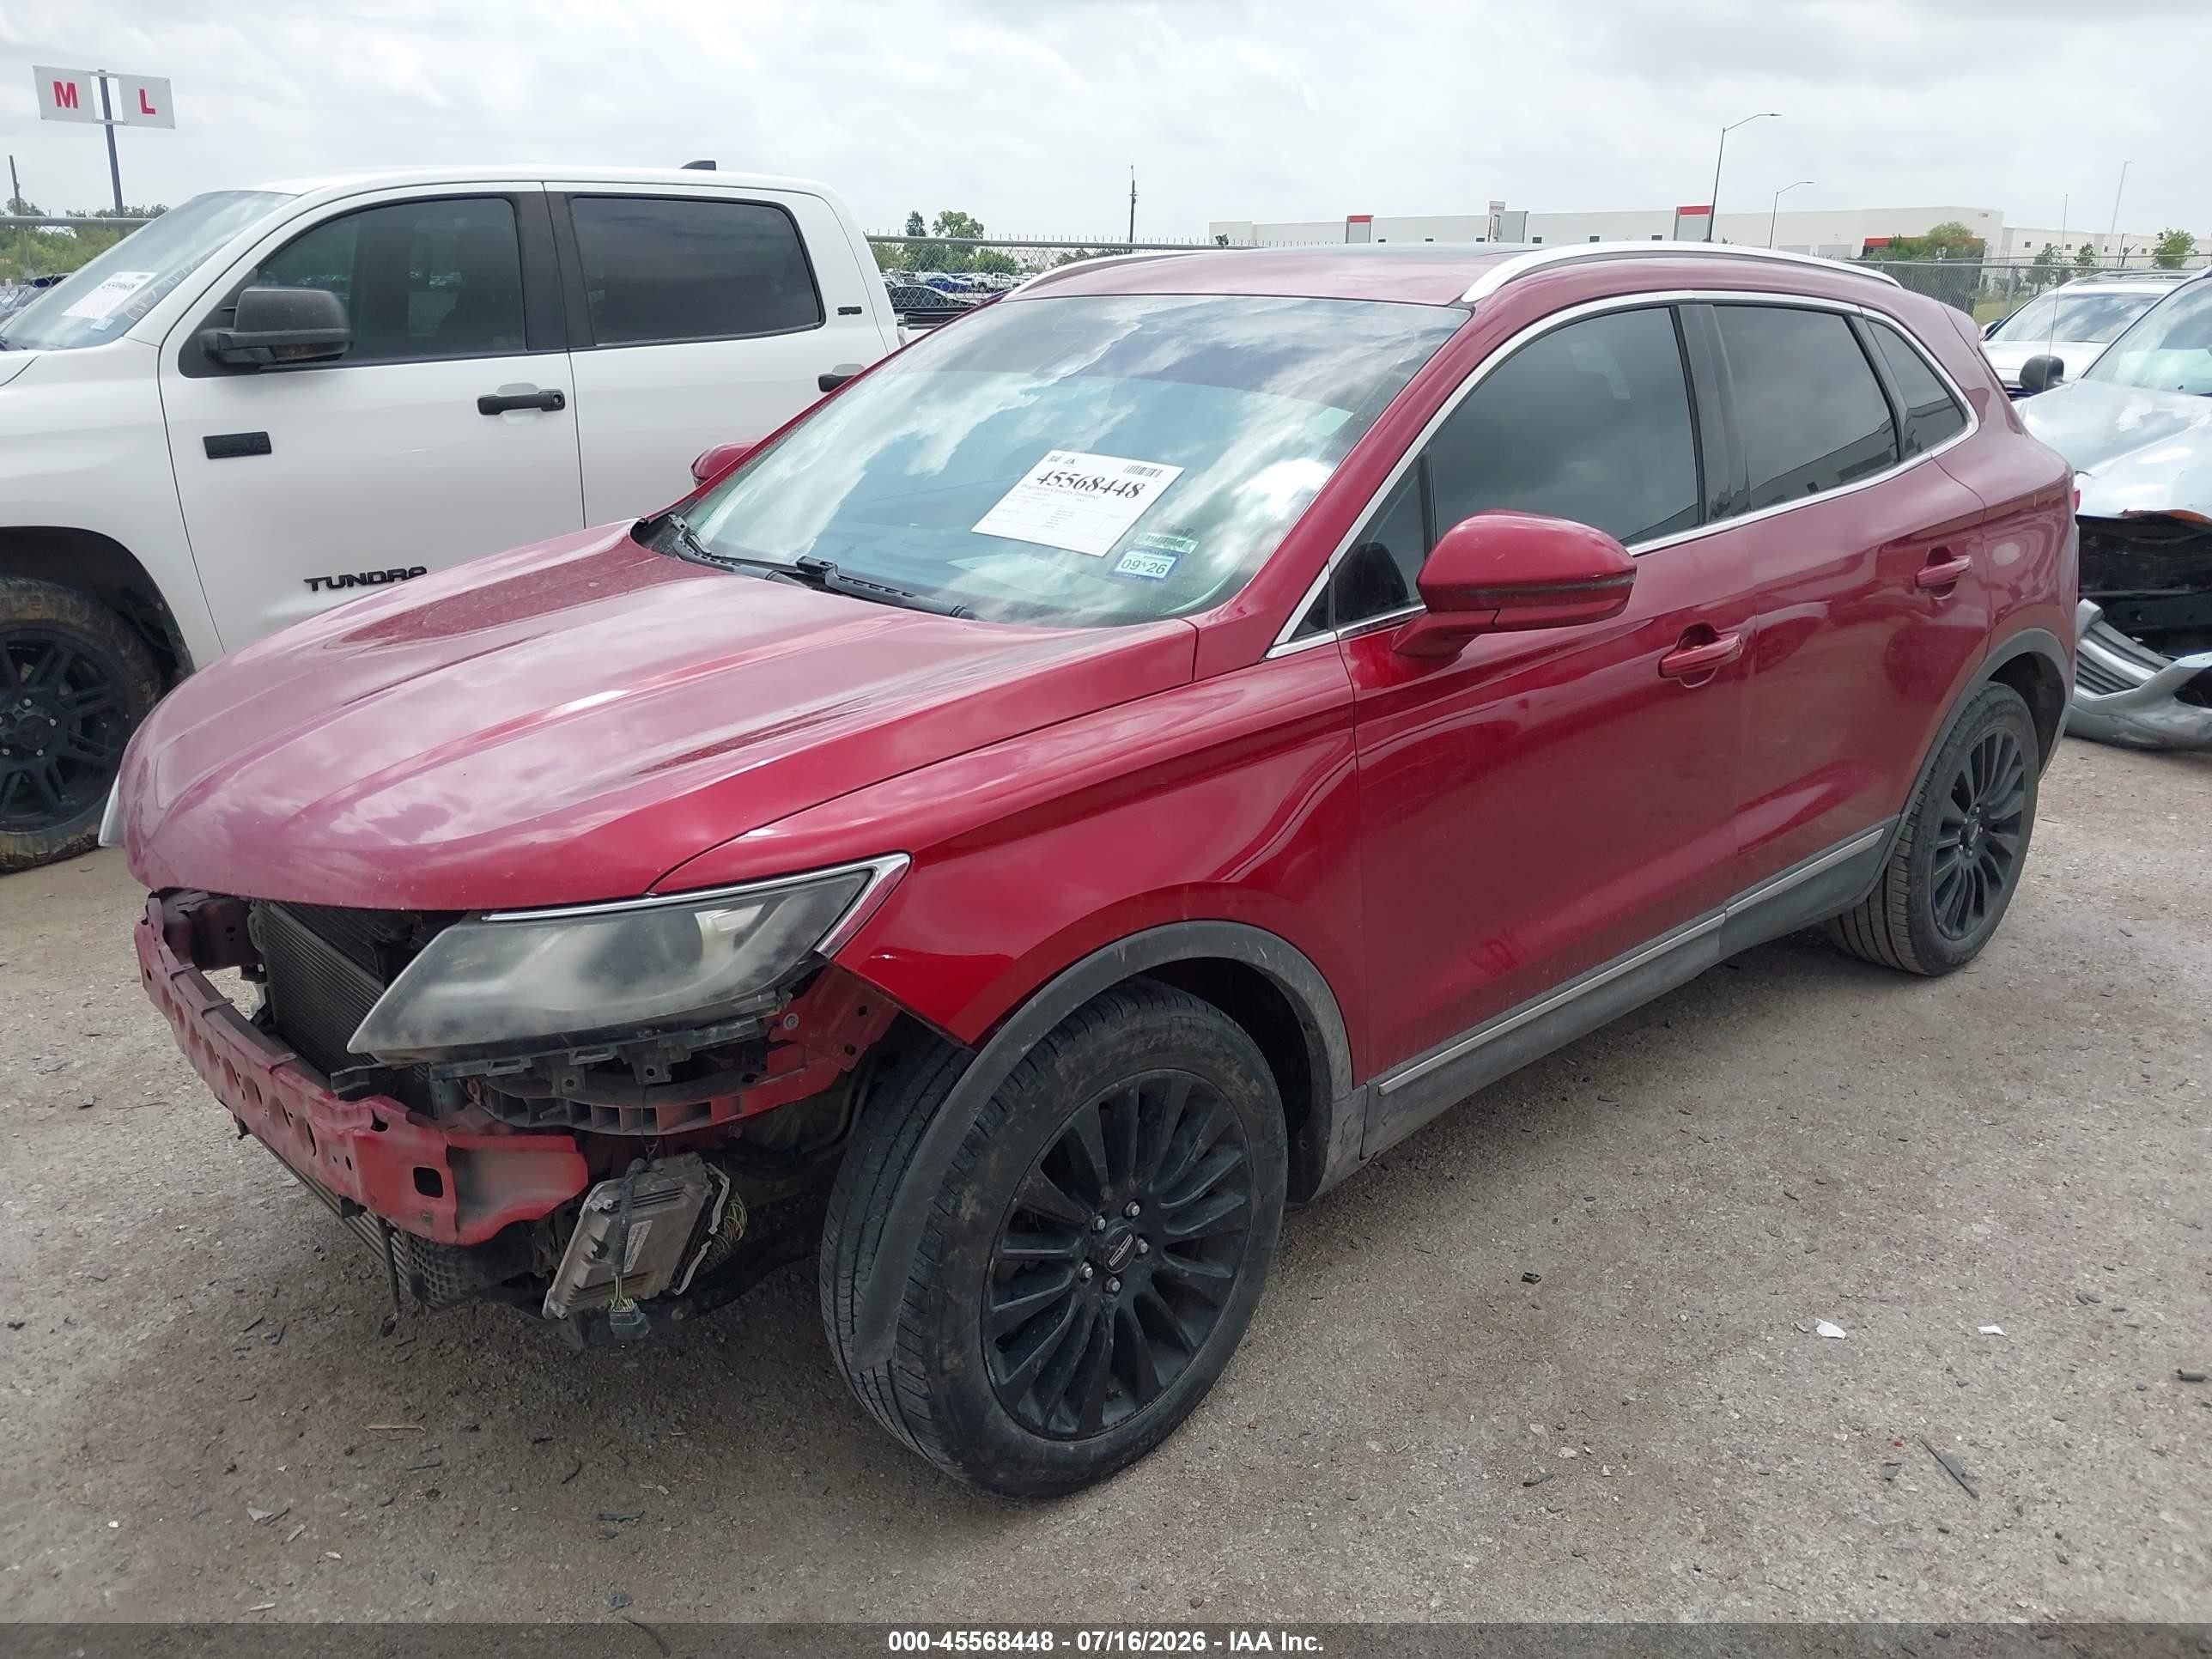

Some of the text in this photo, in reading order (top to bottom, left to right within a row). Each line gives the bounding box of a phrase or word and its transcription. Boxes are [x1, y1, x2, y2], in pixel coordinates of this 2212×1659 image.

[52, 81, 79, 109] M
[138, 88, 156, 115] L
[1036, 470, 1146, 499] 45568448
[303, 565, 428, 592] TUNDRA
[1121, 559, 1168, 574] 09 26
